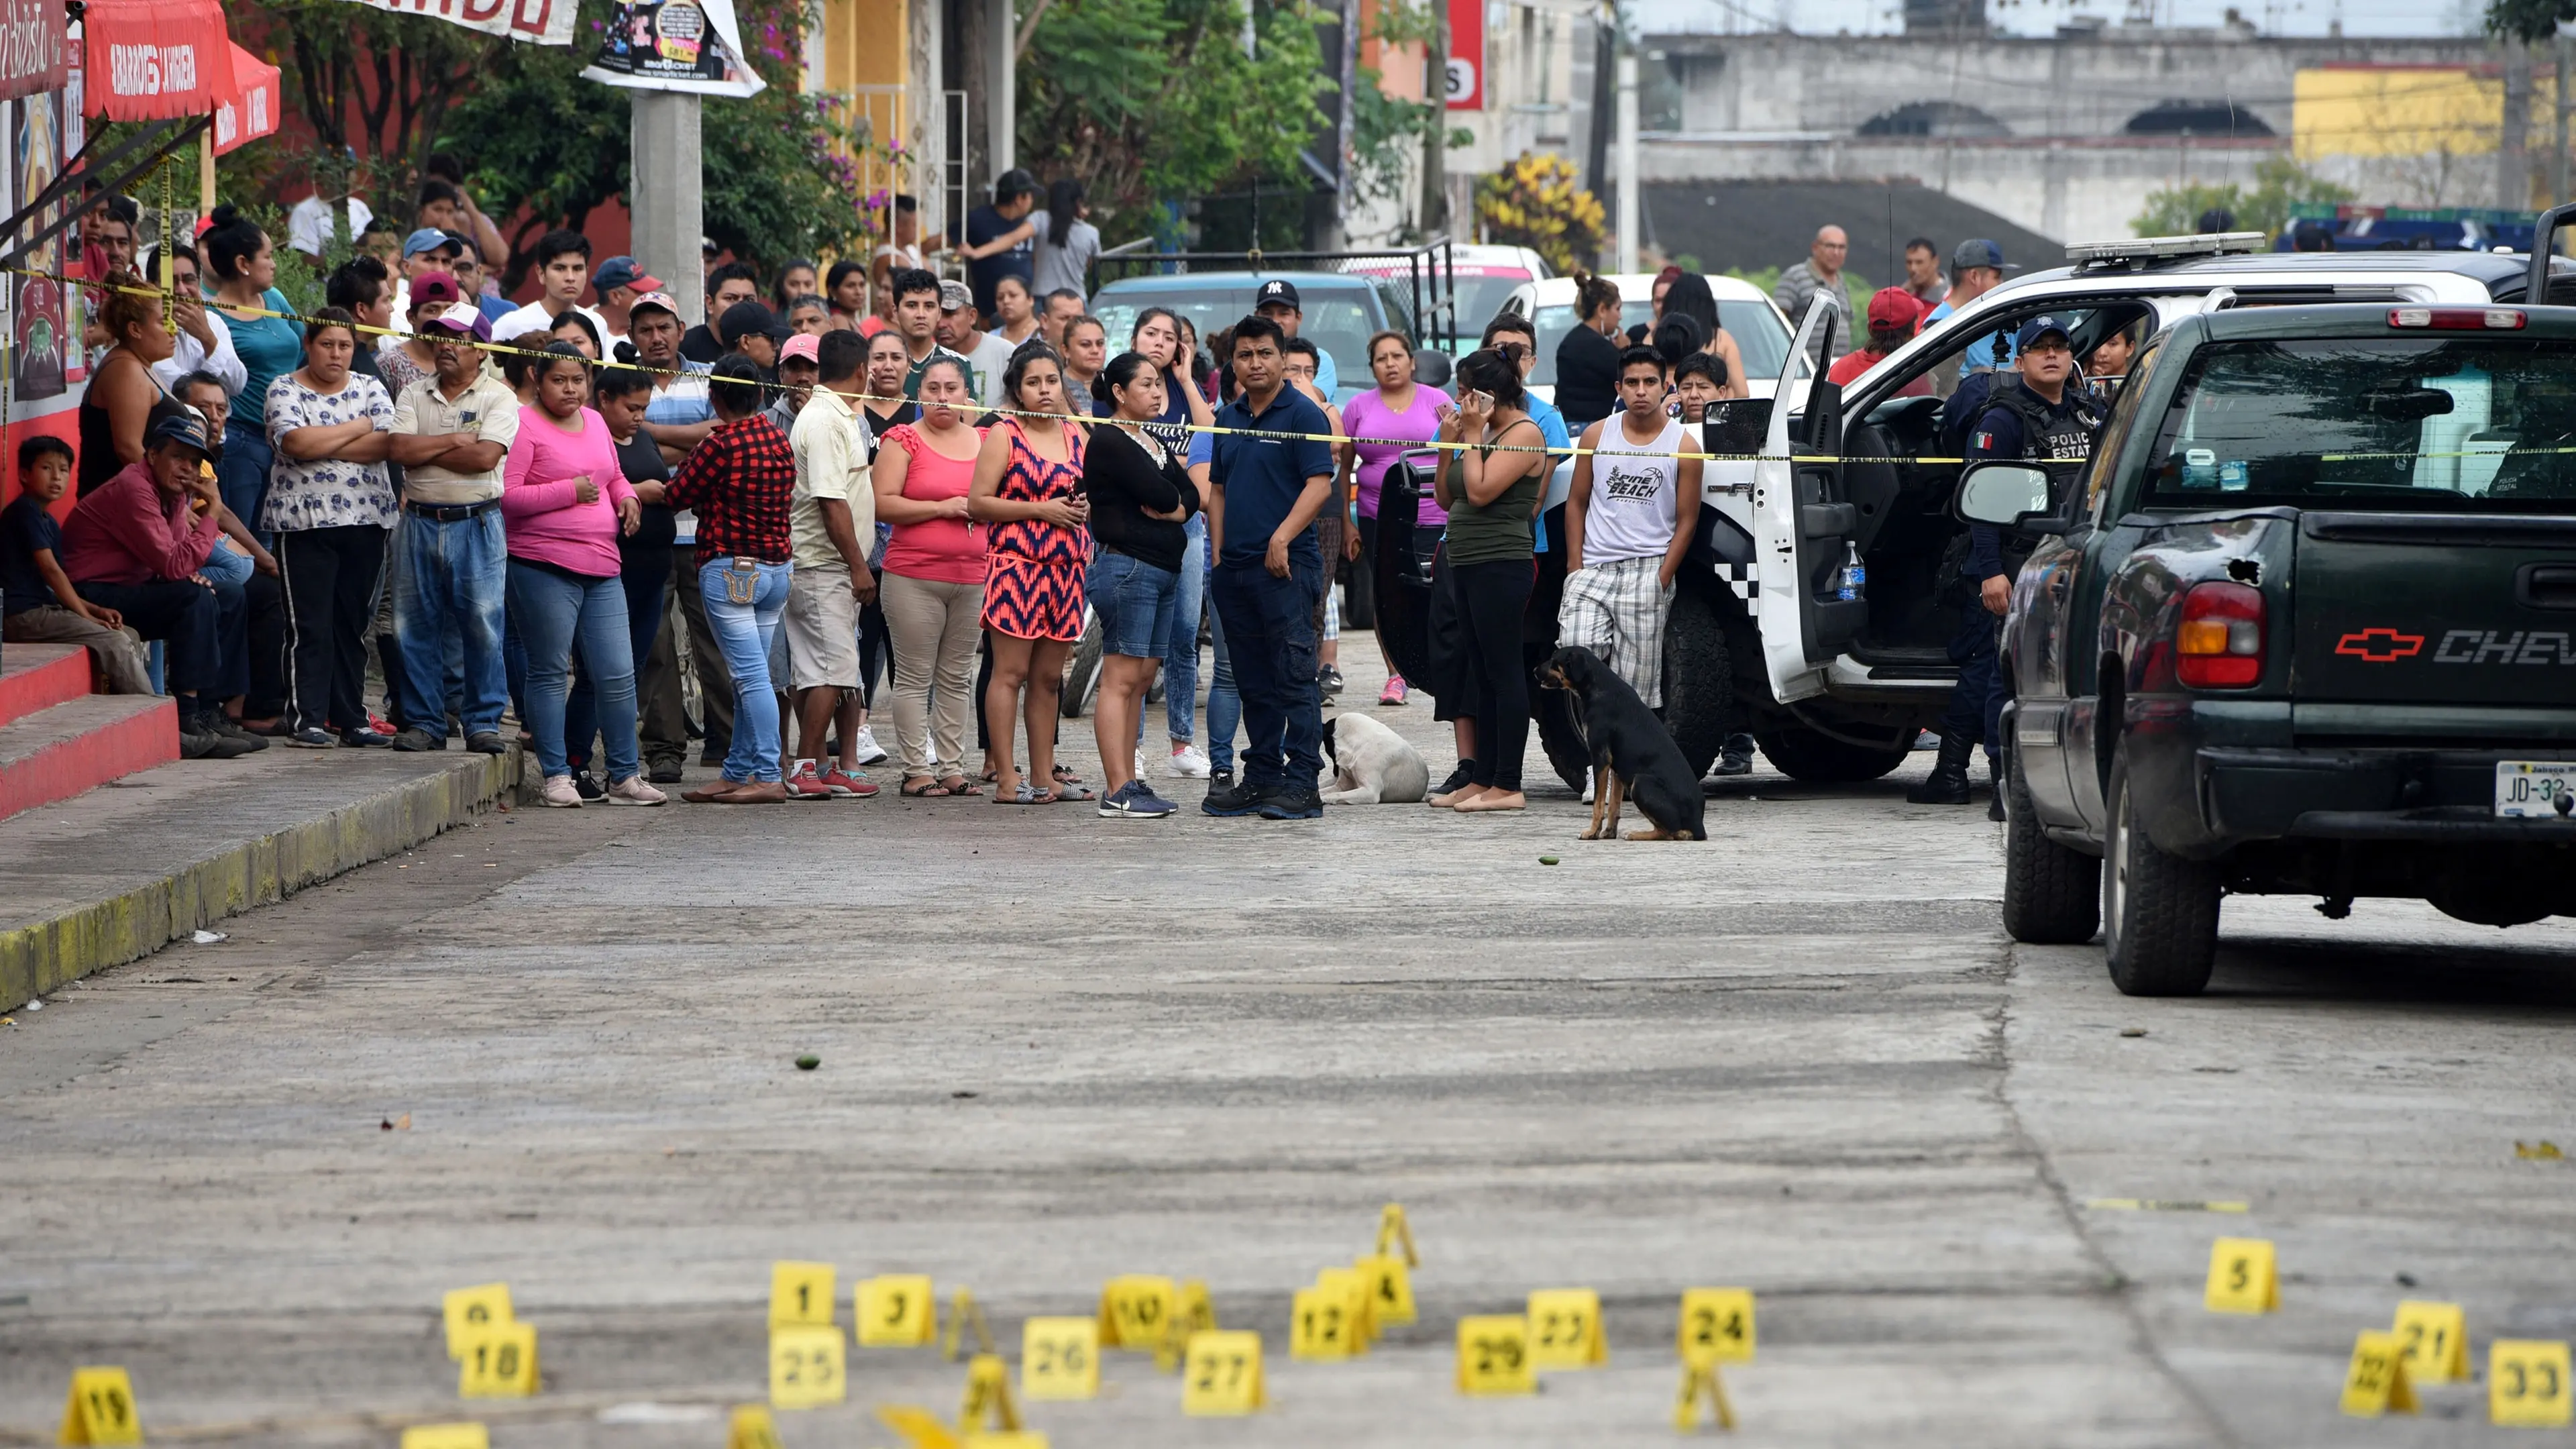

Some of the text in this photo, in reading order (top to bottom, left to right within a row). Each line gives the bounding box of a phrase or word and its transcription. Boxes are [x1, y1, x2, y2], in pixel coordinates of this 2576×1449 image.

[2049, 432, 2090, 447] POLIC
[2052, 445, 2090, 459] ESTAT
[1608, 482, 1658, 498] BEACH
[1618, 474, 1652, 484] PINE
[2229, 1258, 2247, 1290] 5
[795, 1281, 810, 1313] 1
[1303, 1307, 1342, 1342] 12
[1695, 1308, 1744, 1346] 24
[2504, 1360, 2559, 1399] 33
